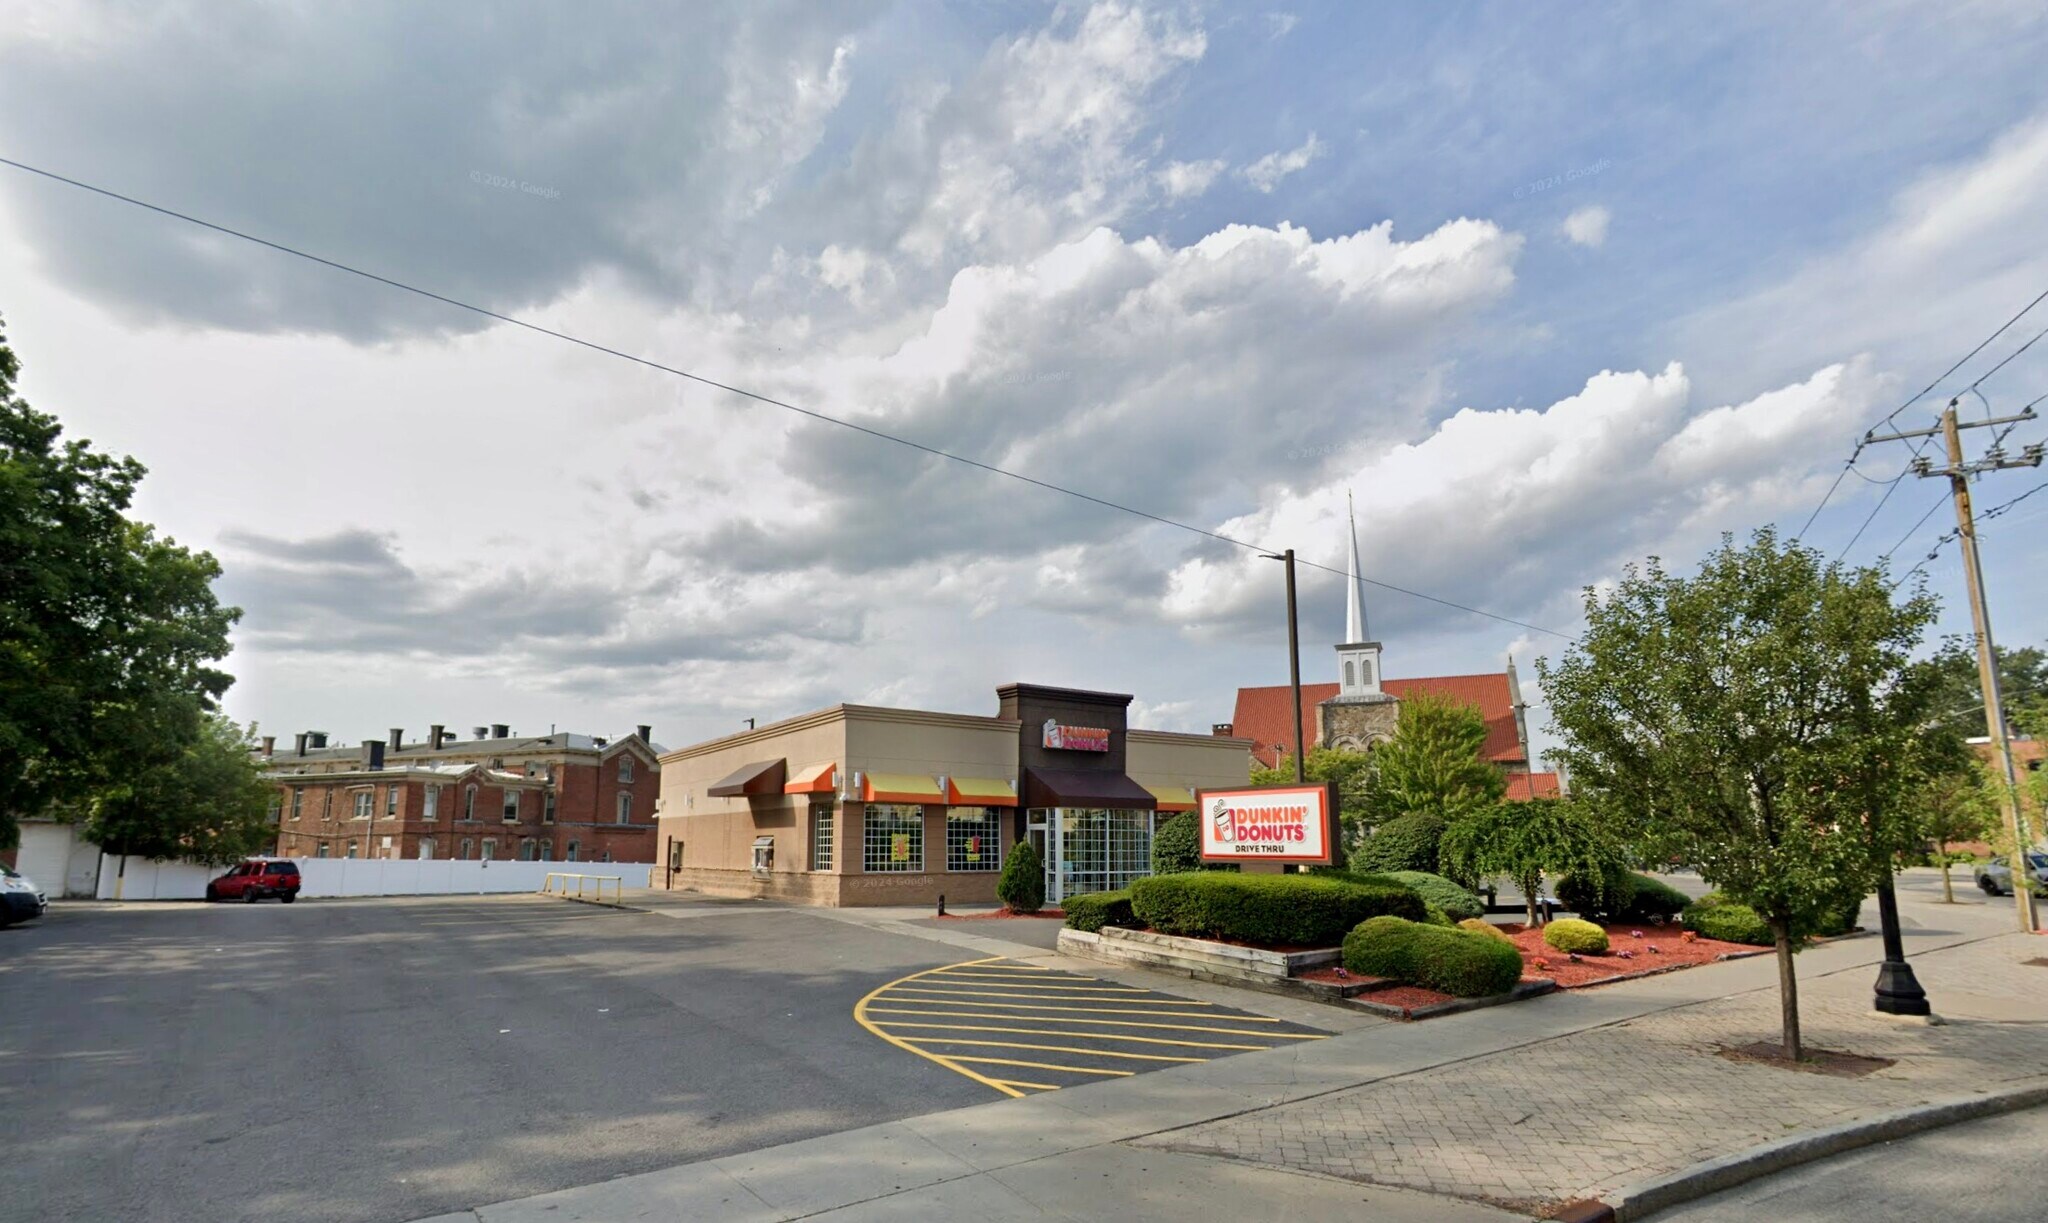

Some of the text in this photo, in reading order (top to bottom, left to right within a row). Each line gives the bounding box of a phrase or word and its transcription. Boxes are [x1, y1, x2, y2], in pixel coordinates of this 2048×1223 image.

[1236, 805, 1308, 825] DUNKIN'
[1237, 824, 1305, 842] DONUTS
[1235, 844, 1285, 853] DRIVE THRU
